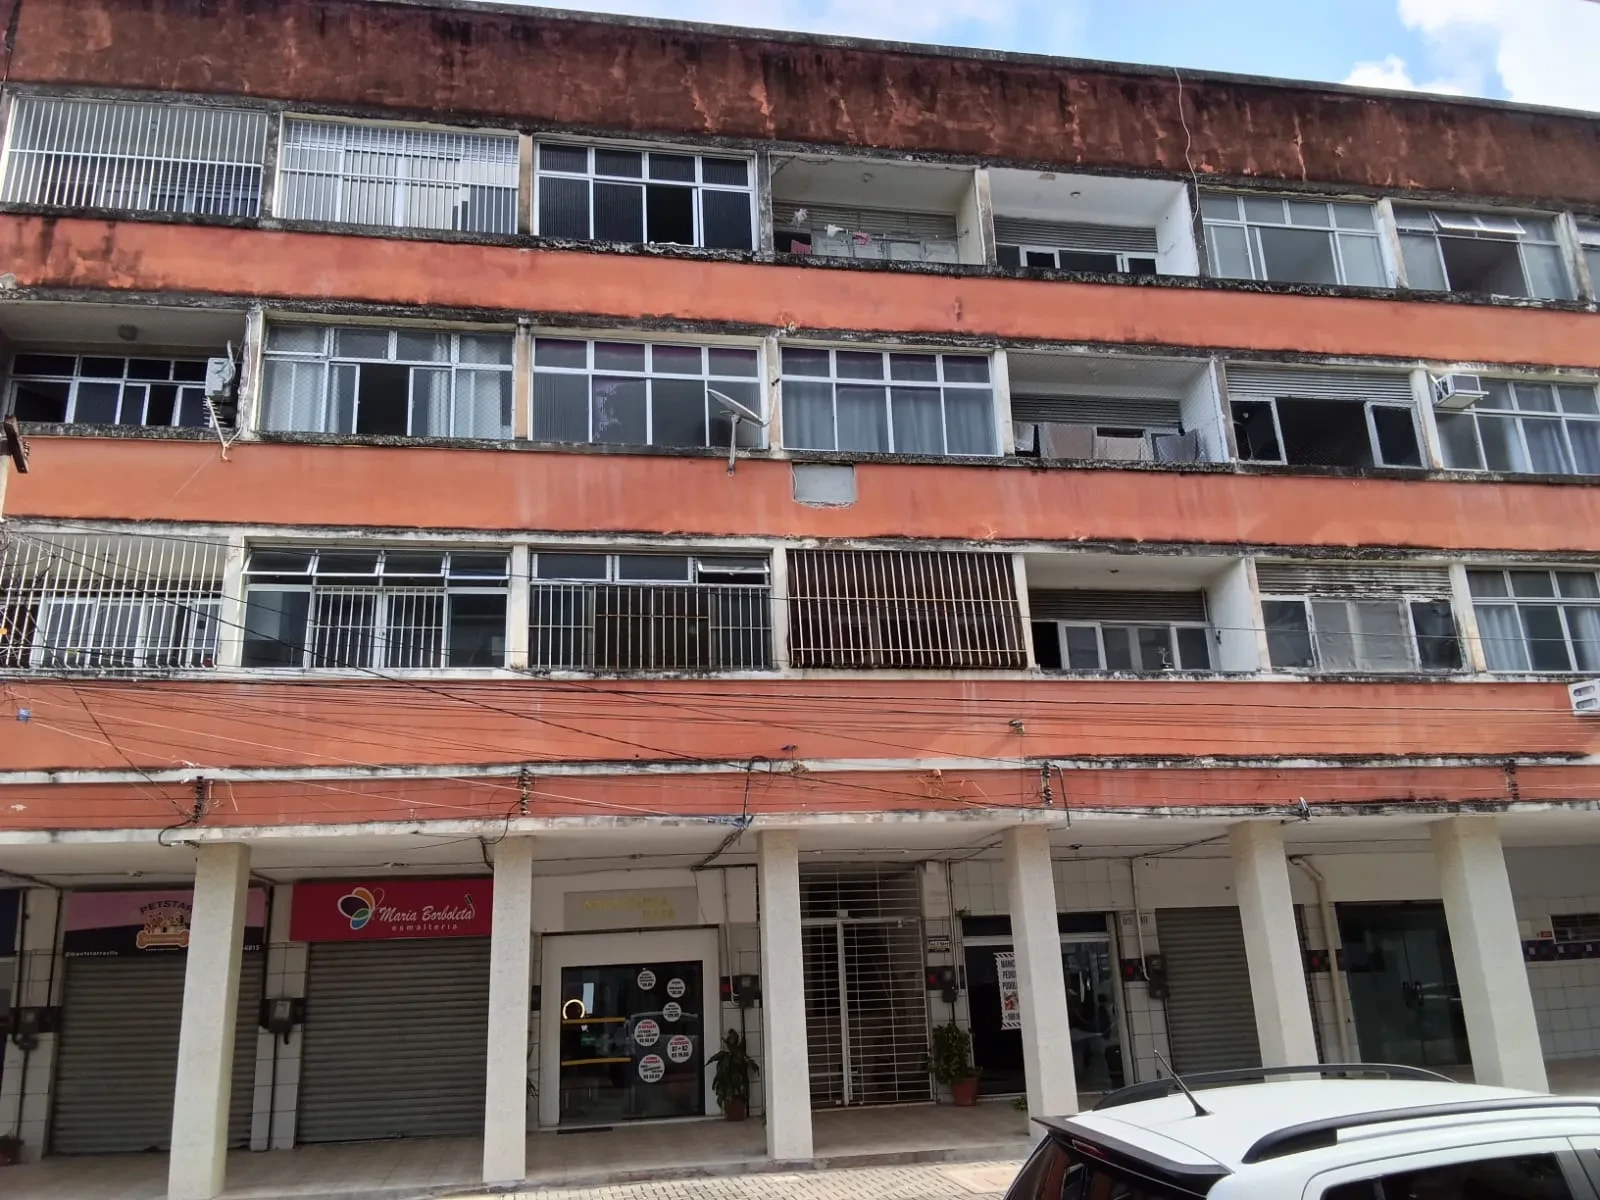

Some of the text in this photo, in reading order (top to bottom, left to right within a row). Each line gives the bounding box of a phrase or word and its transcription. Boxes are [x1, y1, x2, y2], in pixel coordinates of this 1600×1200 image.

[379, 904, 472, 922] Maria Borboleta
[392, 923, 458, 931] esmalteria
